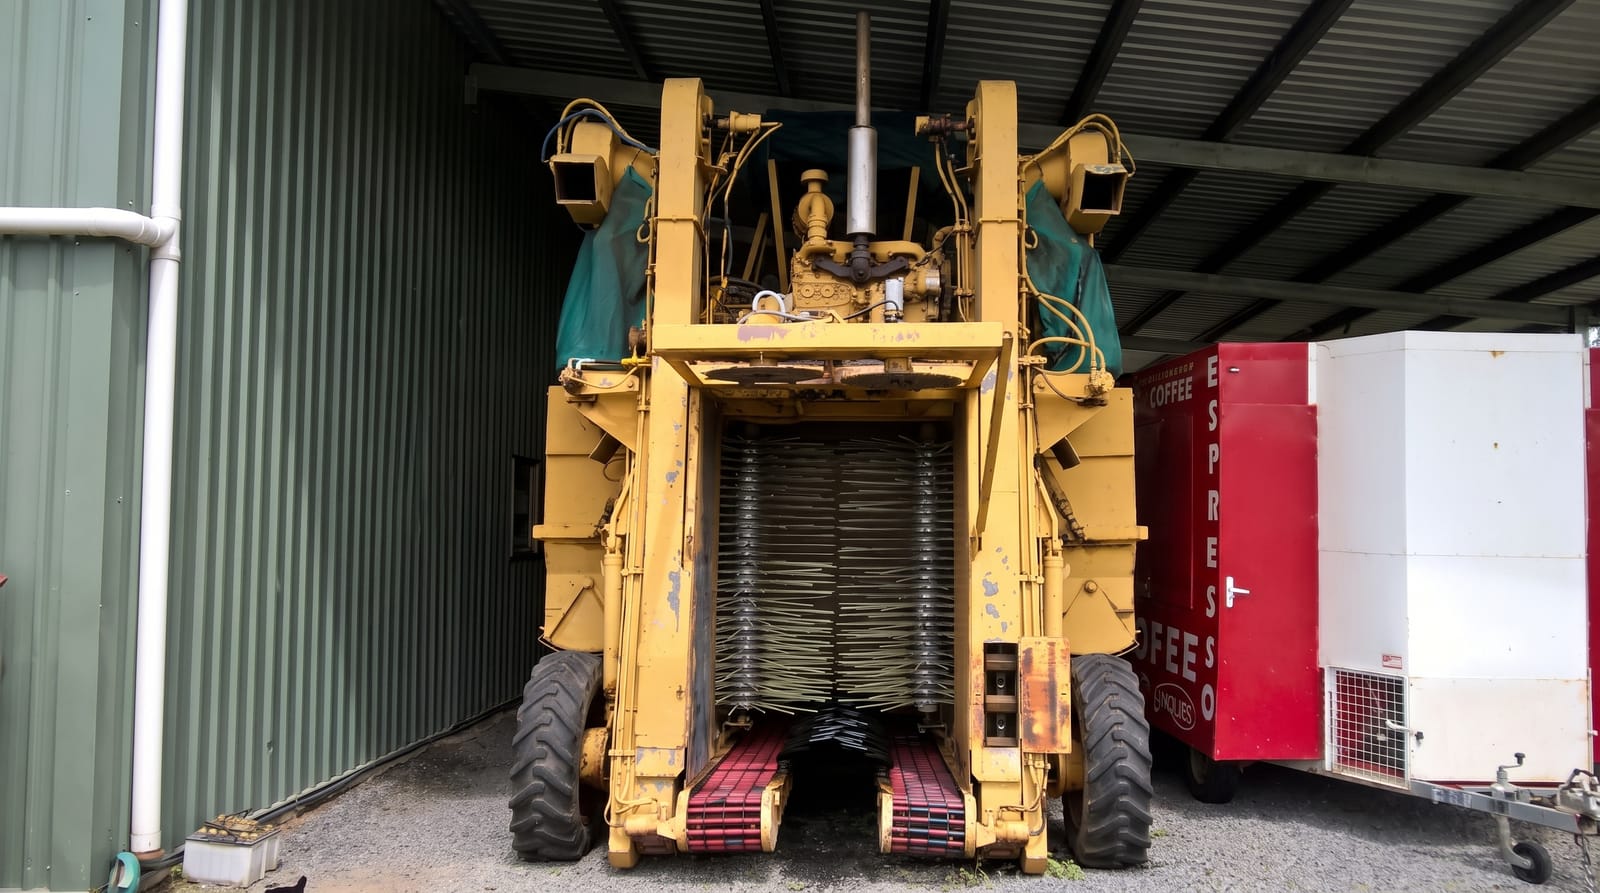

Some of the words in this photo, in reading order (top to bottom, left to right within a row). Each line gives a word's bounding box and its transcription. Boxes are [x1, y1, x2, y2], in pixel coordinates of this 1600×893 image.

[1150, 376, 1193, 408] COFFEE
[1201, 355, 1219, 721] ESPRESSO
[1134, 617, 1199, 683] OFEE
